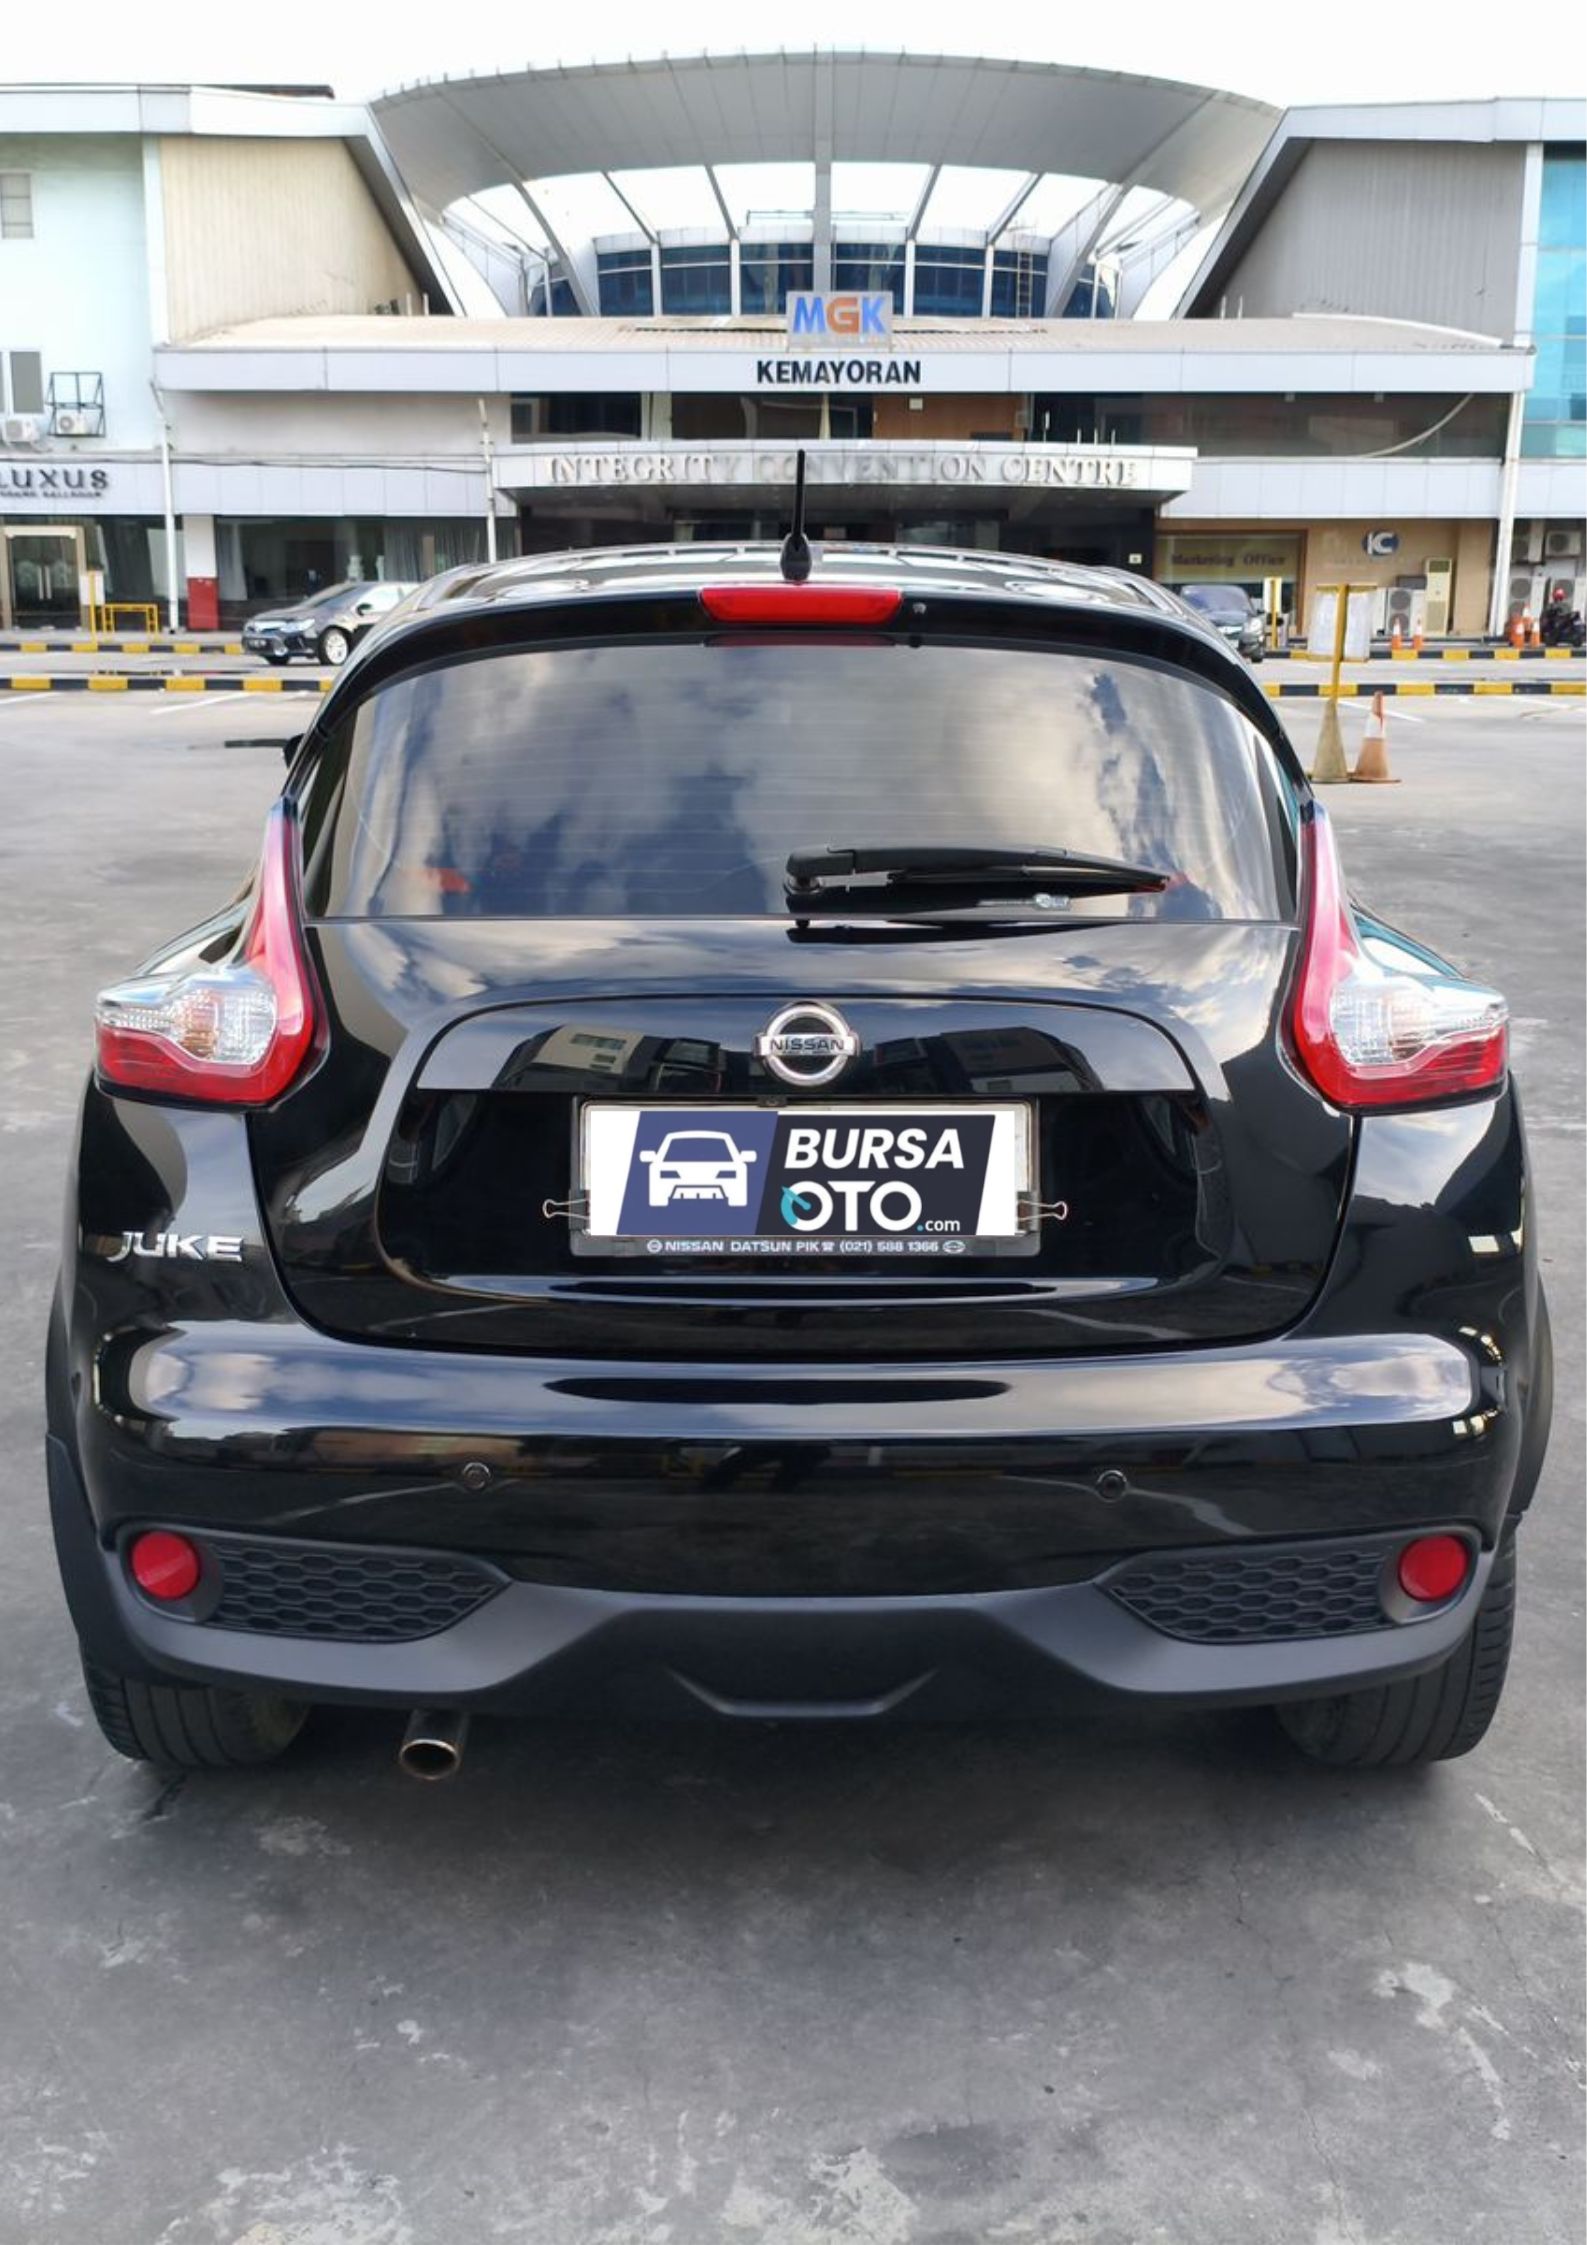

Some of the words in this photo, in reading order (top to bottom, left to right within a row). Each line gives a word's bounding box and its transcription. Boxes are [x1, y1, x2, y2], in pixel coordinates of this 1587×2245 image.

[793, 297, 885, 334] MGK
[757, 360, 921, 384] KEMAYORAN
[549, 455, 741, 482] INTEGRITY
[1000, 456, 1140, 485] CENTRE
[770, 1038, 845, 1051] NISSAN
[106, 1231, 243, 1262] JUKE
[665, 1240, 724, 1252] NISSAN
[731, 1240, 791, 1252] DATSUN
[797, 1240, 818, 1252] PIK
[840, 1240, 873, 1253] (021)
